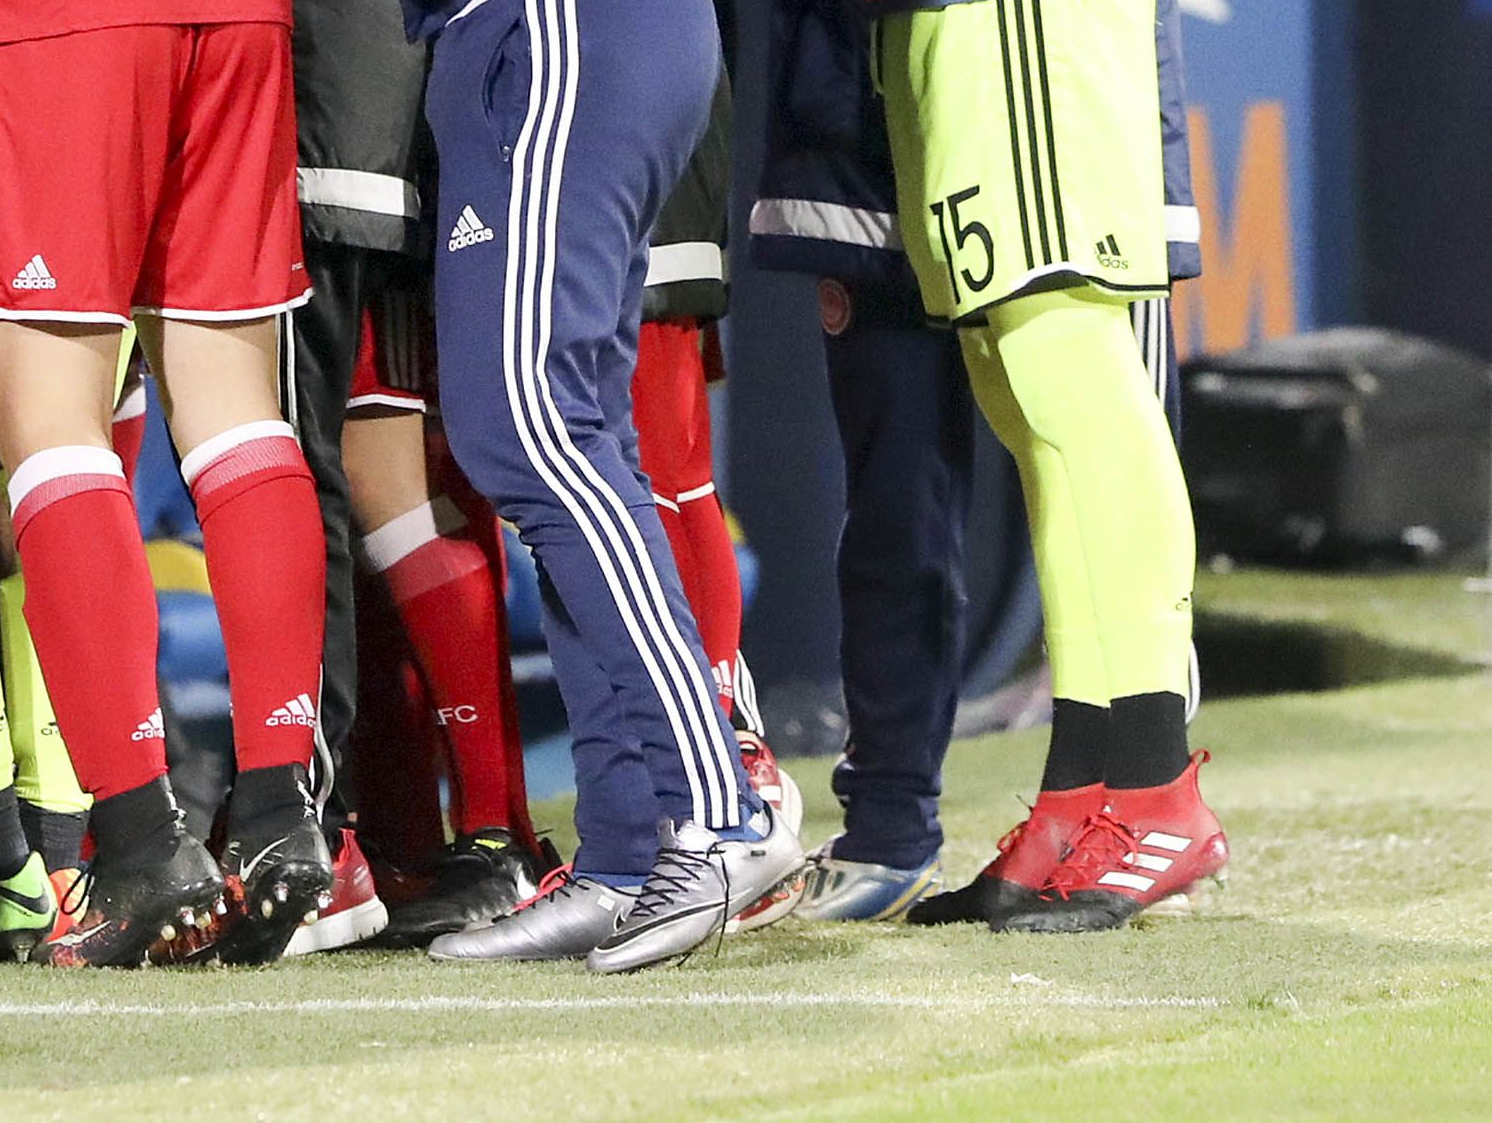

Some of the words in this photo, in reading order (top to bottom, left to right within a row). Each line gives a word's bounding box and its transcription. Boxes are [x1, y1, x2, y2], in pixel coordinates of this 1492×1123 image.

[449, 227, 494, 252] adidas
[929, 184, 994, 304] 15
[11, 277, 57, 289] adidas
